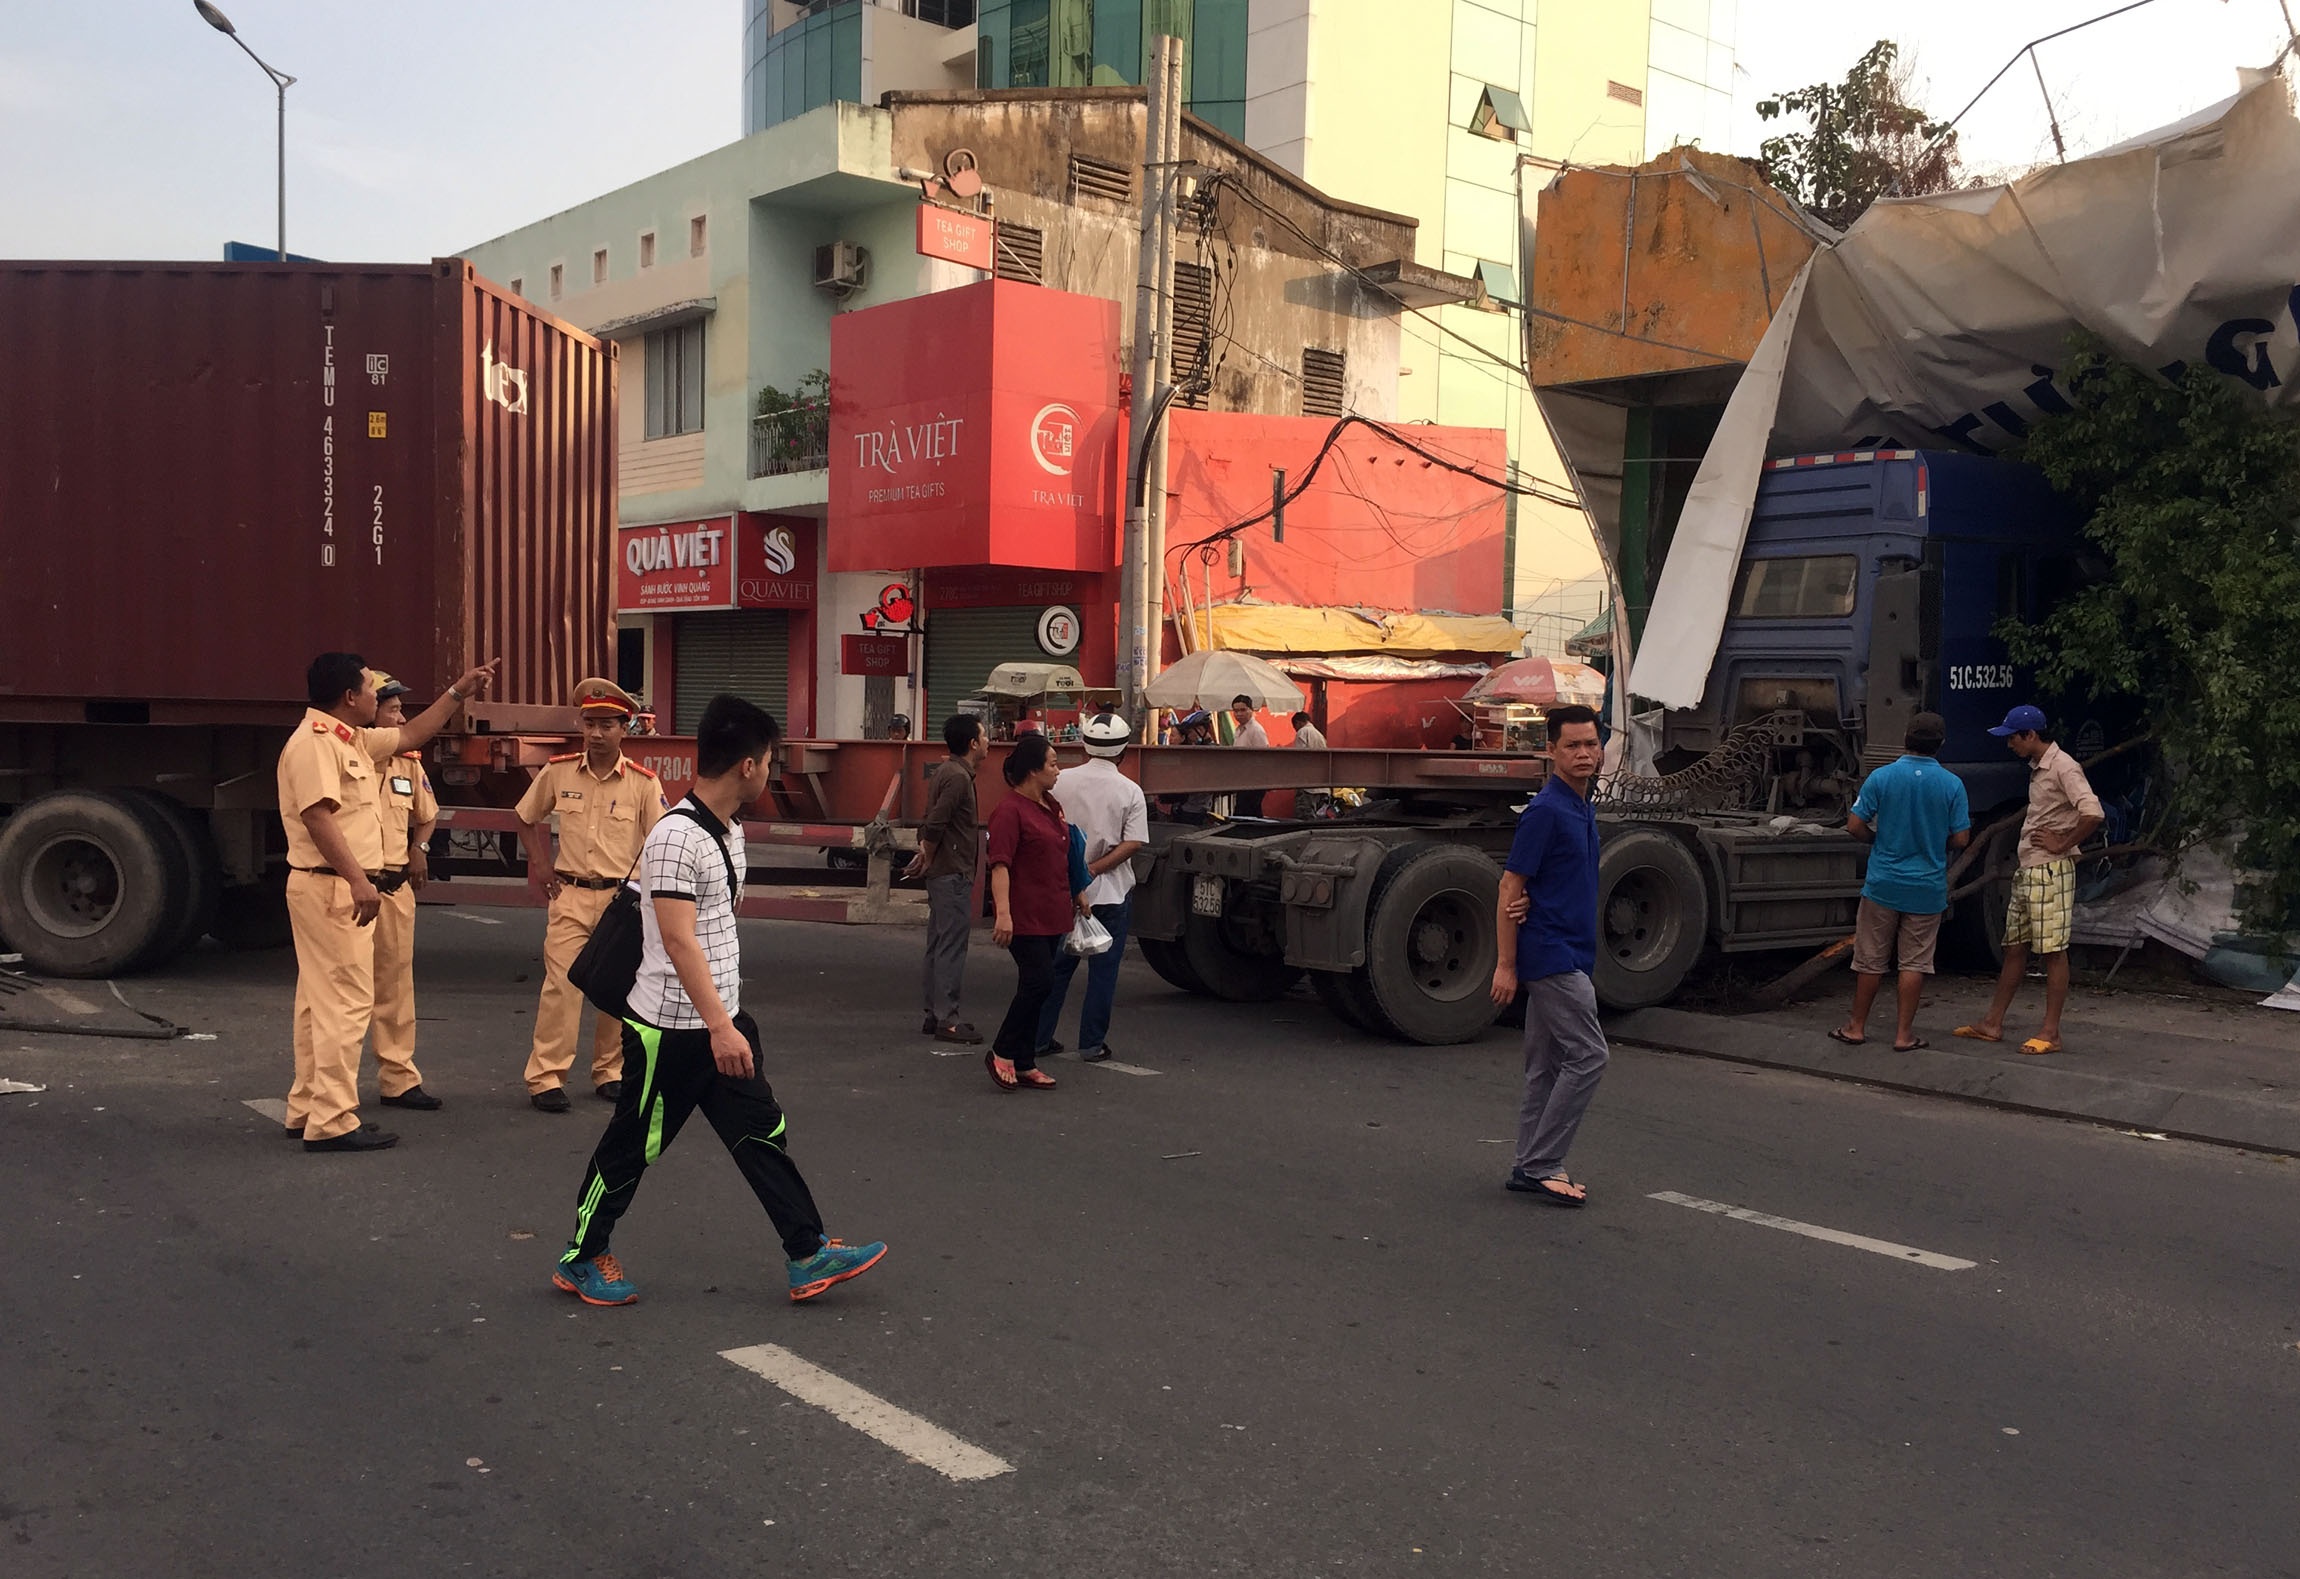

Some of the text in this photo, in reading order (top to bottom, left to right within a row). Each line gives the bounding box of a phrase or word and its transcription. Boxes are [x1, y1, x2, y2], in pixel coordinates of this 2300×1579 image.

[935, 219, 976, 240] TEA GIFT
[943, 236, 969, 253] SHOP
[323, 325, 335, 407] TEMU
[371, 374, 385, 385] 81
[854, 412, 964, 474] TRÀ VIỆT
[323, 415, 334, 537] 463324
[868, 482, 945, 503] PREMIUM TEA GIFTS
[373, 485, 383, 565] 22G1
[626, 523, 724, 578] QUÀ VIỆT
[859, 643, 896, 656] TEA GIFT
[865, 657, 890, 668] SHOP
[1949, 664, 2014, 690] 51C.532.56
[1200, 880, 1216, 897] 51C
